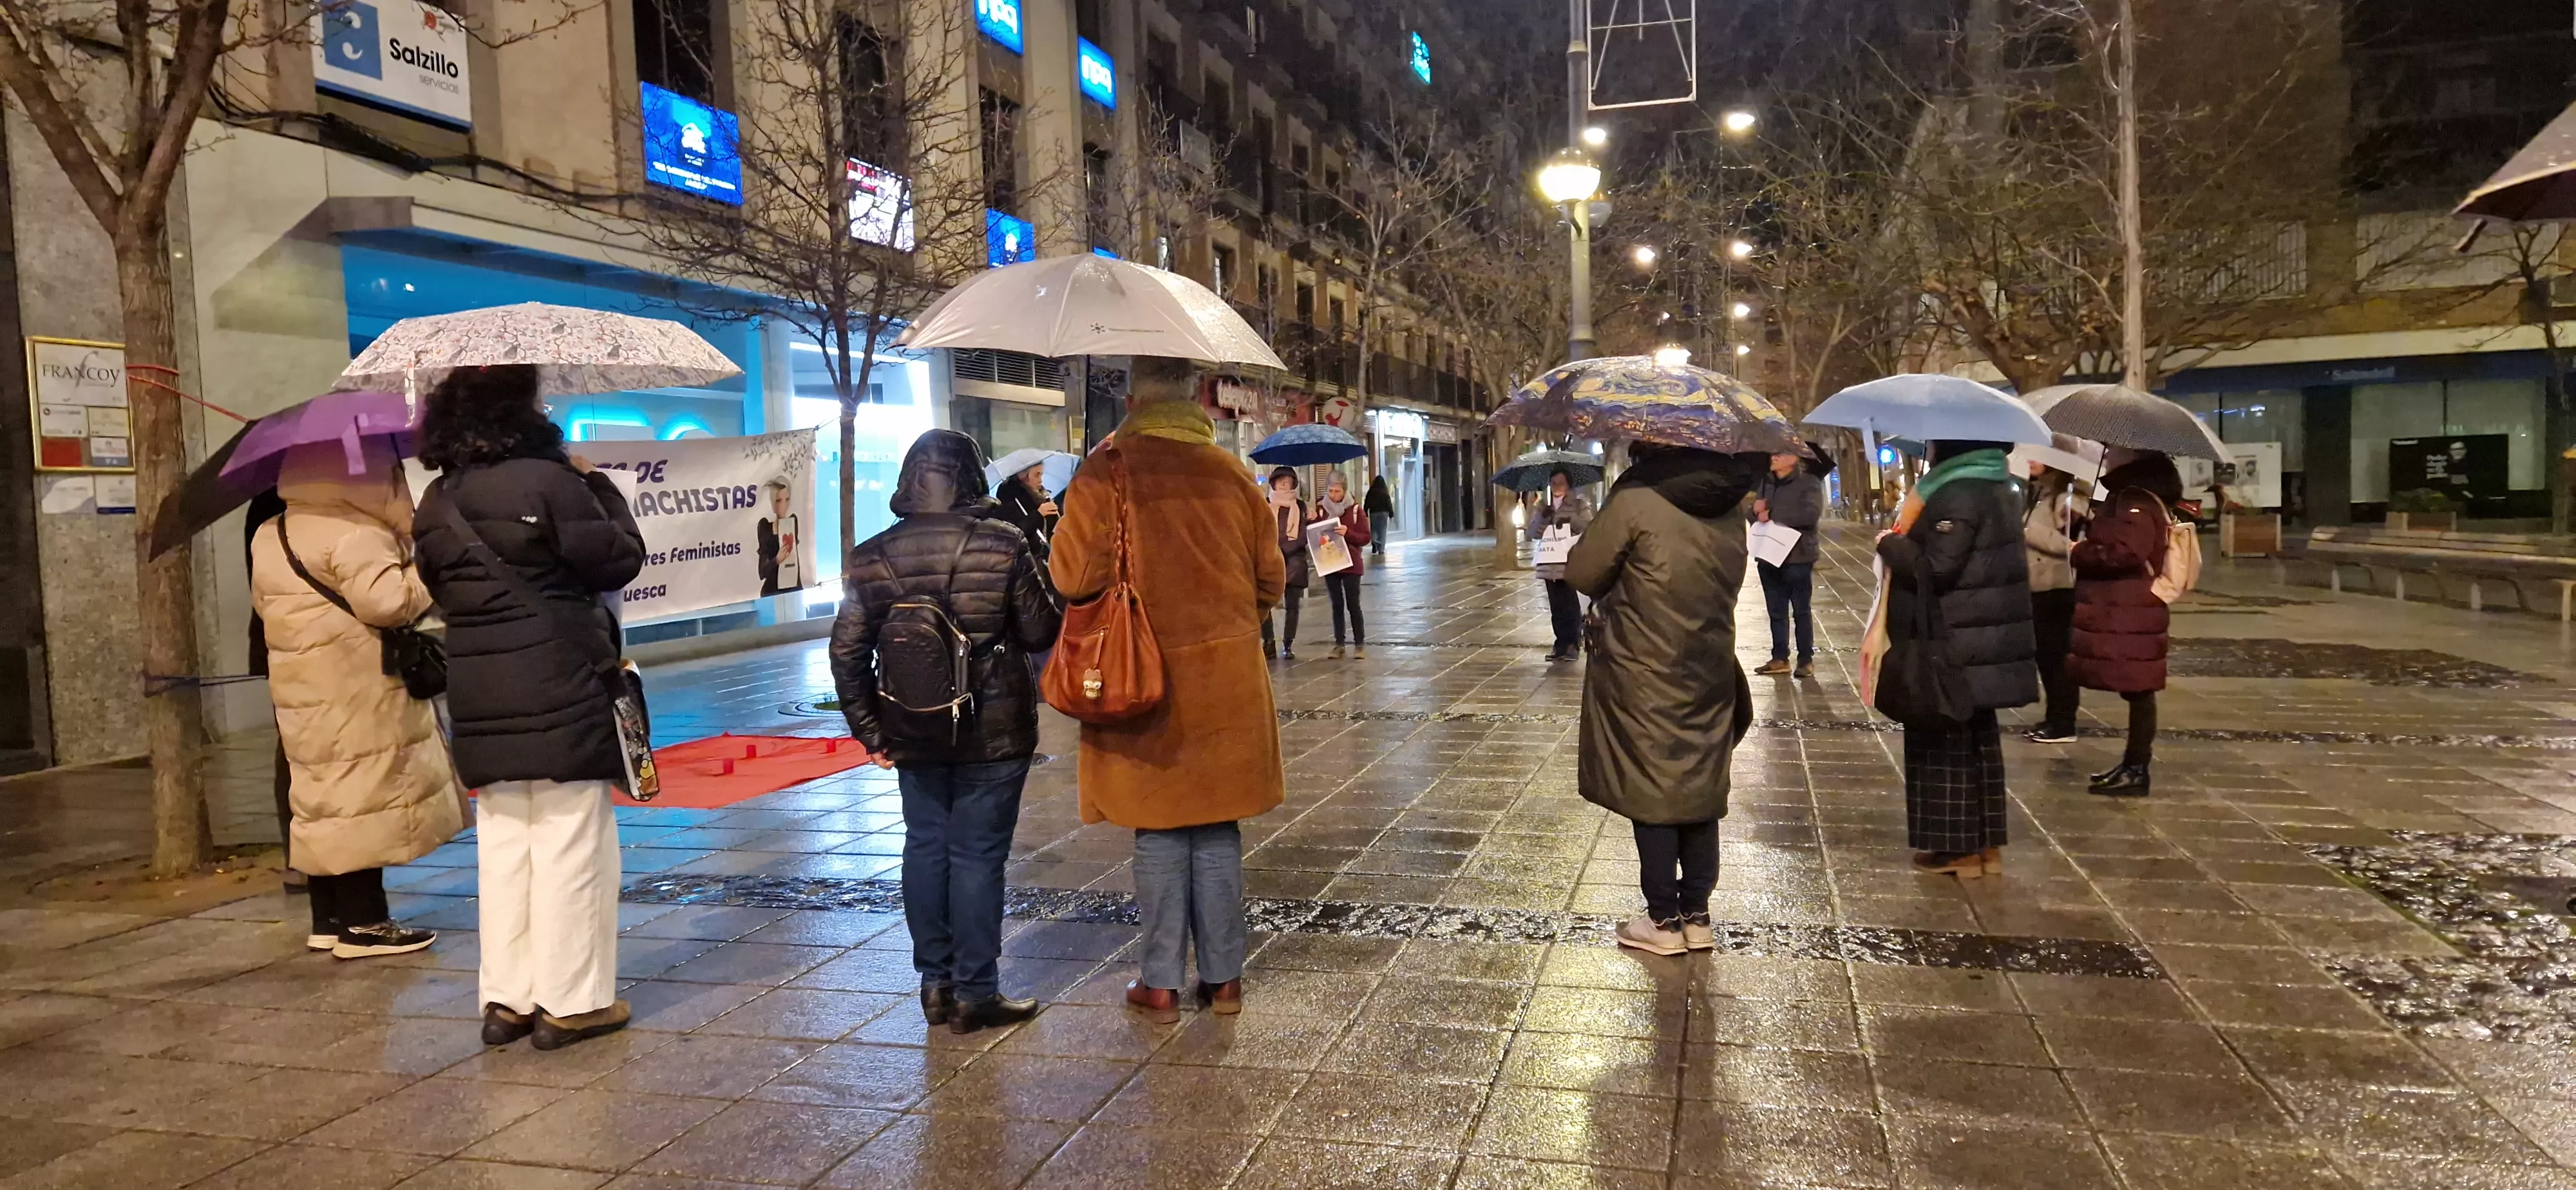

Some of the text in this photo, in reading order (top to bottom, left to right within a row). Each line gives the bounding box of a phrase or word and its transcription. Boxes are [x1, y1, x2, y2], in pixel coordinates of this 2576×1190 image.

[390, 37, 459, 78] Salzillo
[634, 459, 669, 484] DE
[645, 540, 741, 567] res Feministas
[623, 583, 667, 603] uesca
